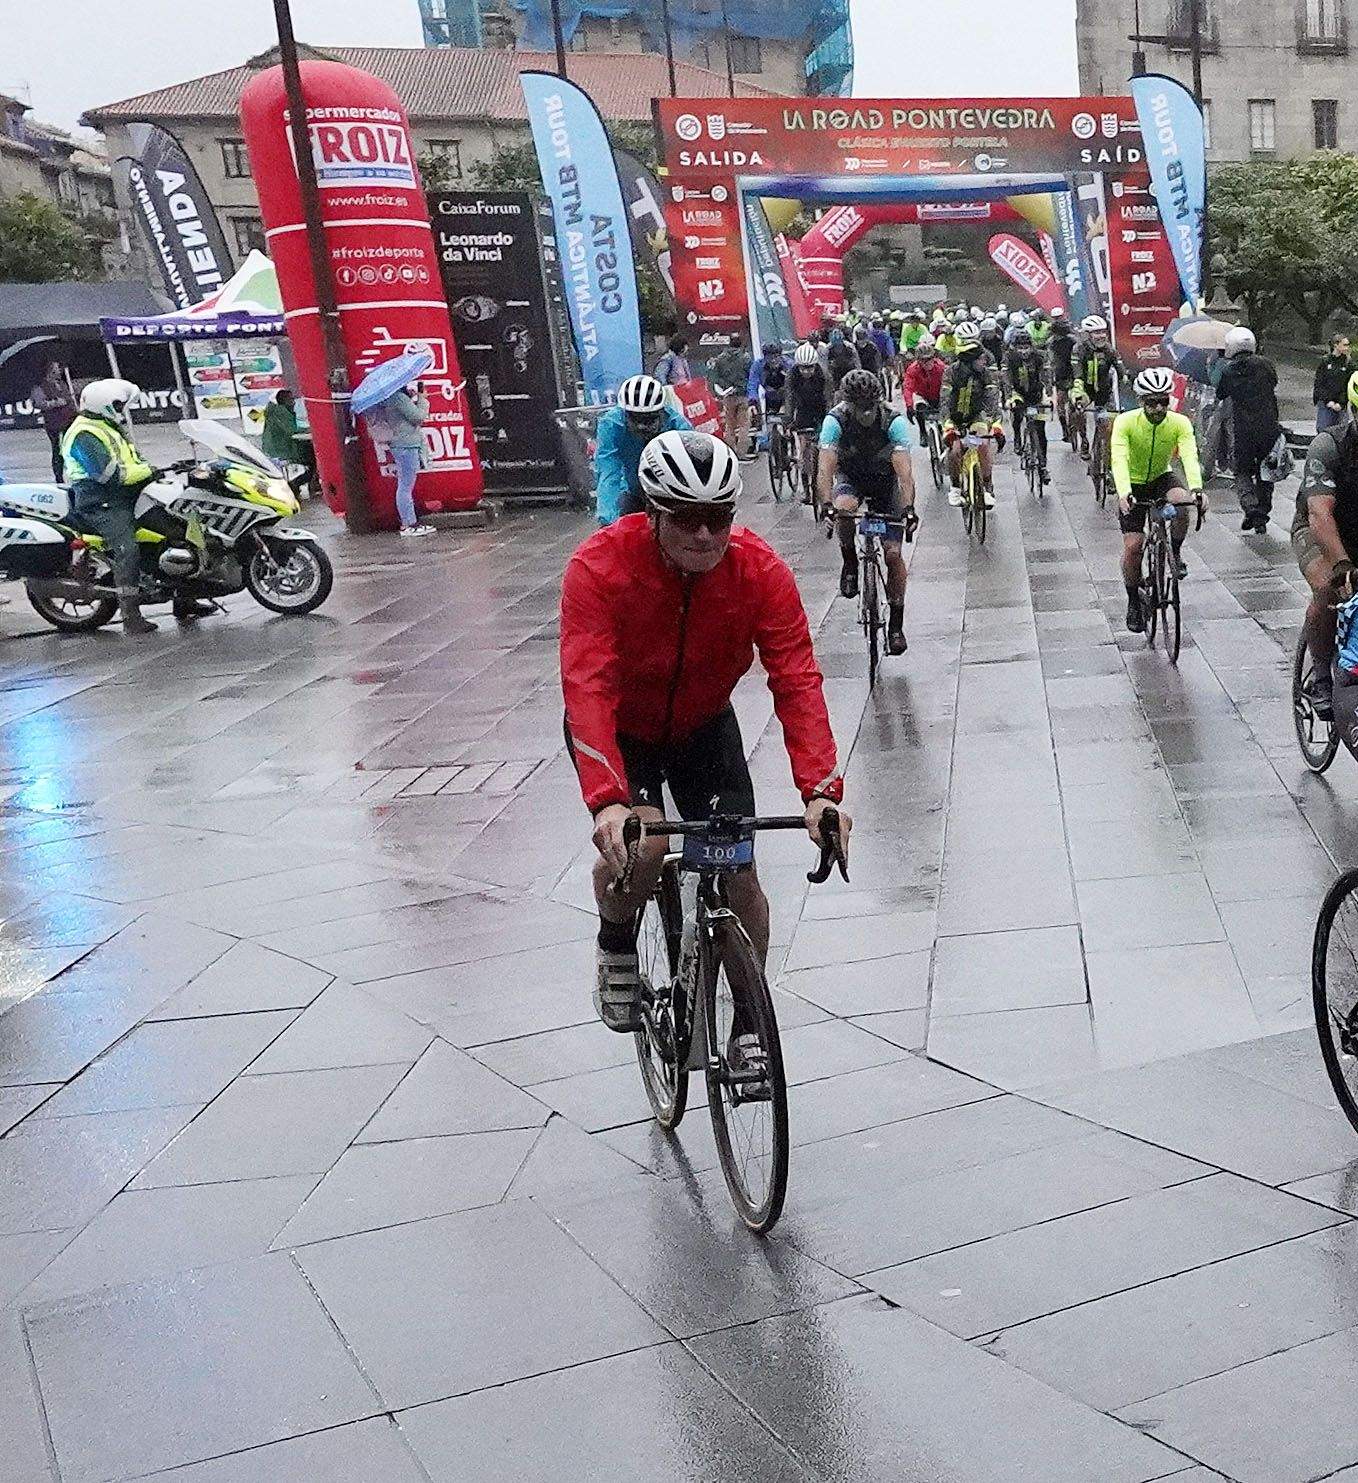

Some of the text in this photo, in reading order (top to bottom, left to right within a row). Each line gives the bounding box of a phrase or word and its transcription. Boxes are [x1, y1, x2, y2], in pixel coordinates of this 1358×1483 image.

[783, 109, 805, 130] LA
[812, 109, 884, 130] ROAD
[892, 108, 1056, 130] PONTEVEDRA
[680, 150, 764, 167] SALIDA
[438, 200, 521, 215] CaixaForum
[440, 231, 514, 246] Leonardo
[442, 247, 503, 262] da Vinci
[1131, 271, 1158, 291] N2
[703, 846, 736, 860] 100
